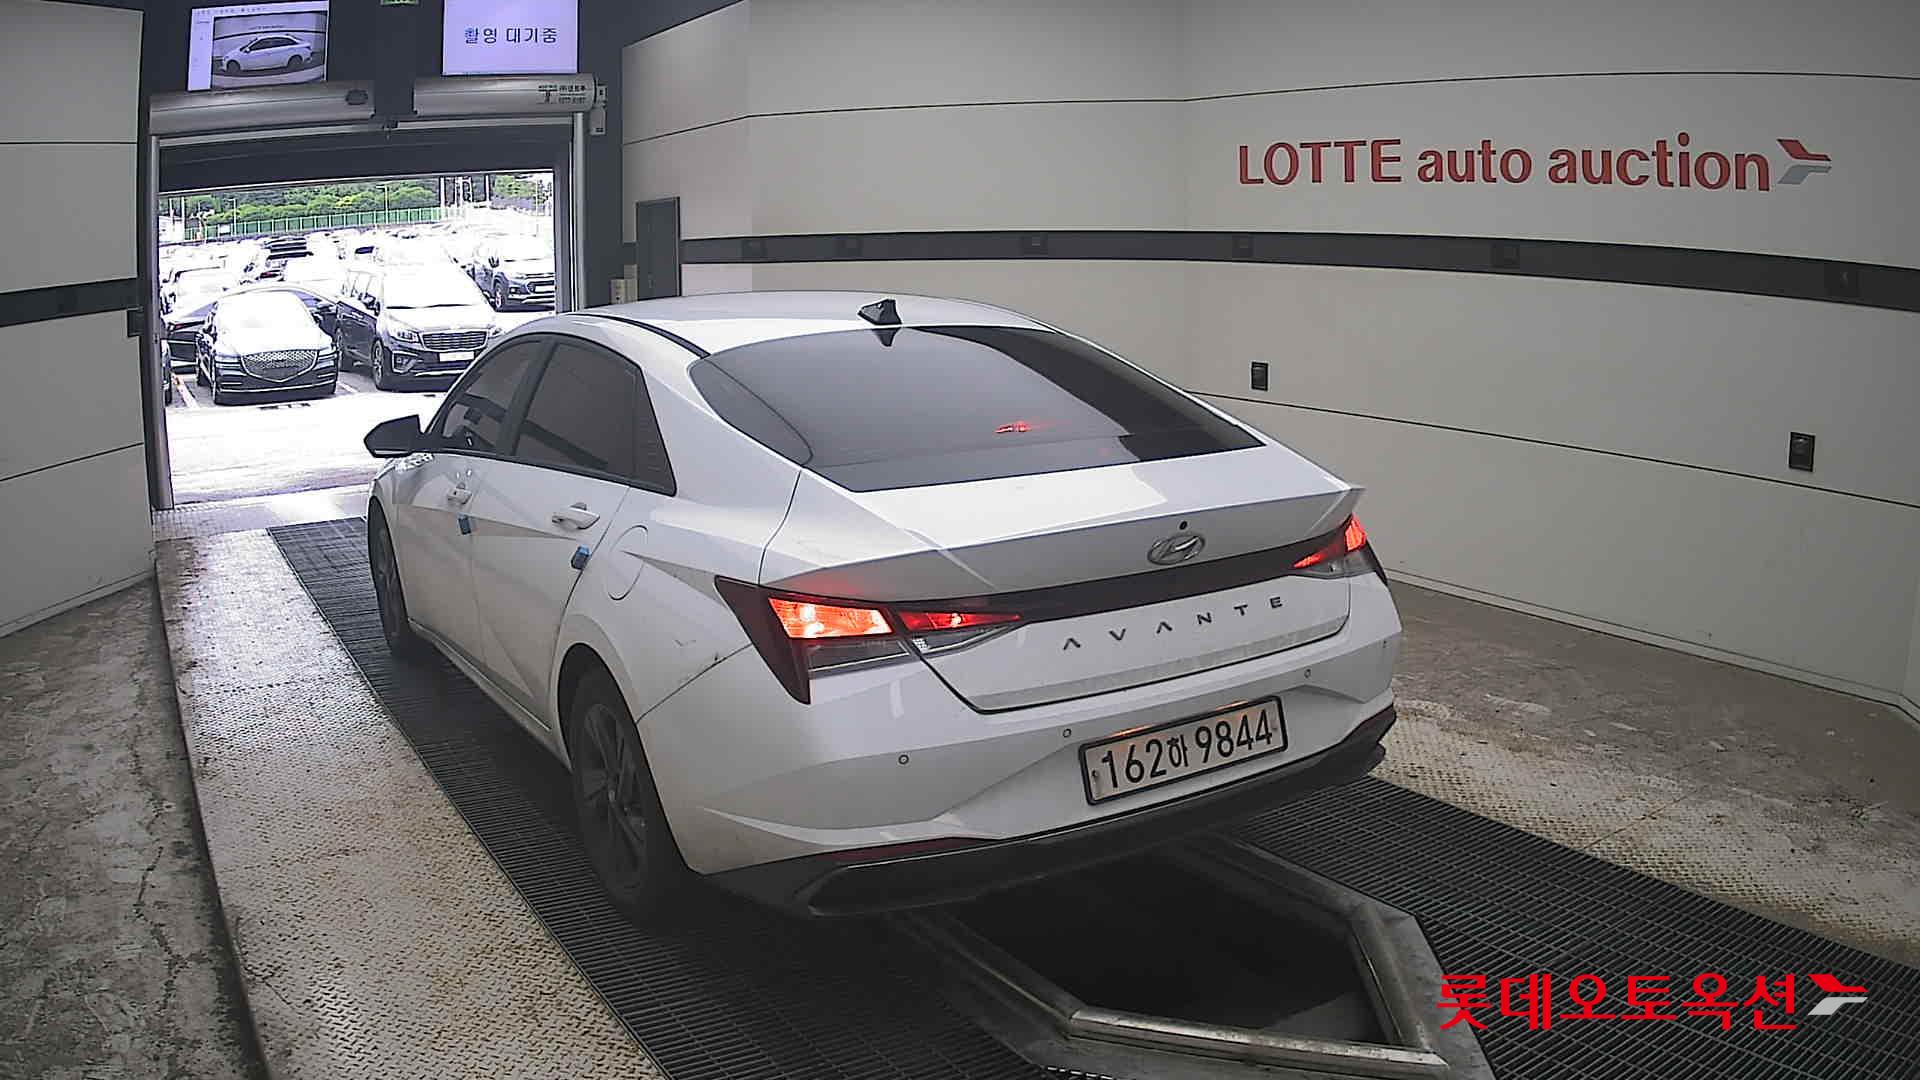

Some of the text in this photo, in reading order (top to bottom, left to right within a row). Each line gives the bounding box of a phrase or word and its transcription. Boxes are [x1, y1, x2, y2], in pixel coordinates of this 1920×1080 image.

[464, 27, 557, 44] 촬영 대기중
[1239, 132, 1770, 191] LOTTE auto auction
[1063, 596, 1283, 651] AVANTE
[1101, 708, 1273, 789] 162하 9844
